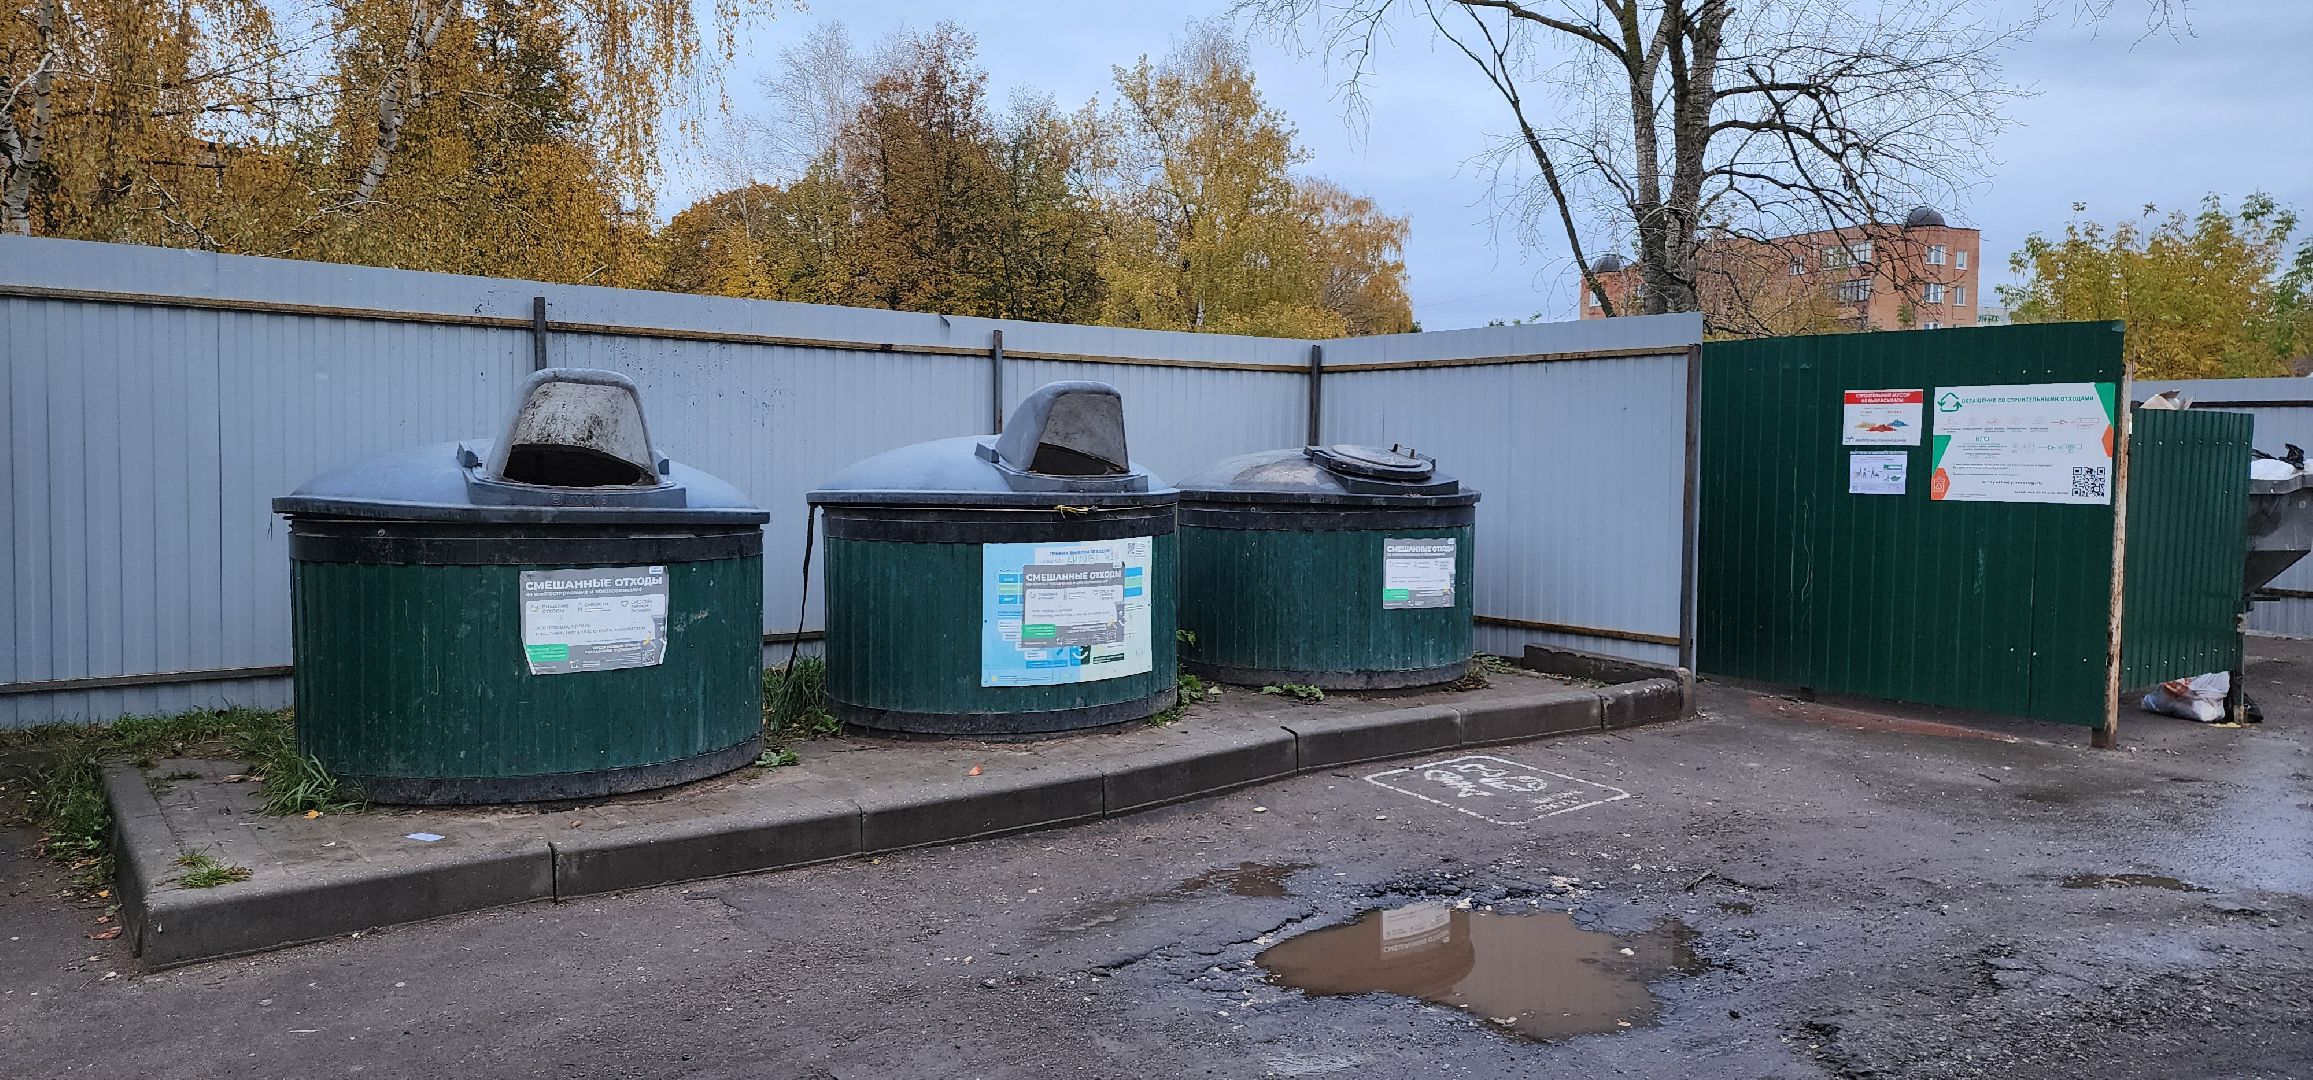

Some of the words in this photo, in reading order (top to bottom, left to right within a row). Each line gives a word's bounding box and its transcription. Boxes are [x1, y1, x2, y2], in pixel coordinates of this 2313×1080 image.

[2060, 395, 2094, 403] ОТХОДАМИ
[1386, 545, 1432, 553] СМЕШАННЫЕ
[1025, 571, 1088, 582] СМЕШАННЫЕ
[1089, 569, 1122, 580] ОТХОДЫ
[525, 578, 612, 591] СМЕШАННЫЕ
[614, 576, 663, 587] ОТХОДЫ
